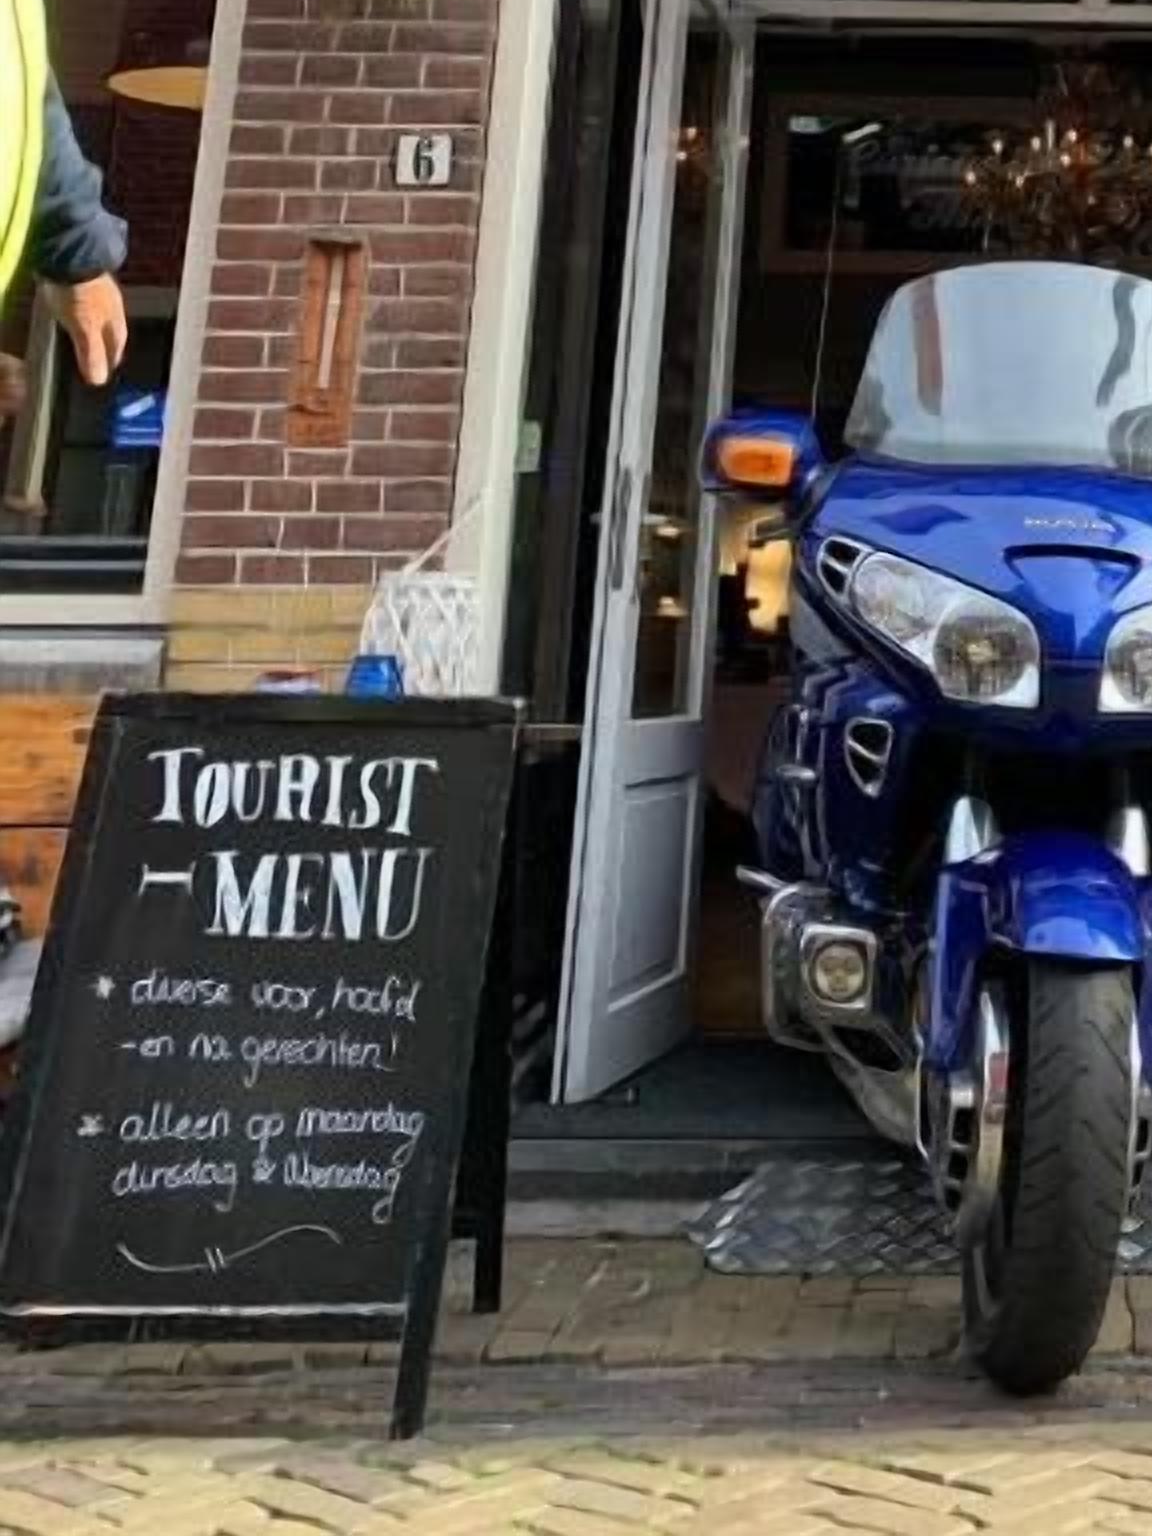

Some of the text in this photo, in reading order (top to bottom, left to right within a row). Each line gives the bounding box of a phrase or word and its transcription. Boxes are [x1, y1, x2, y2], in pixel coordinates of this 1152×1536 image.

[412, 134, 436, 184] 6
[147, 746, 439, 836] TOURIST
[119, 1101, 230, 1141] alleen
[246, 1113, 294, 1159] op
